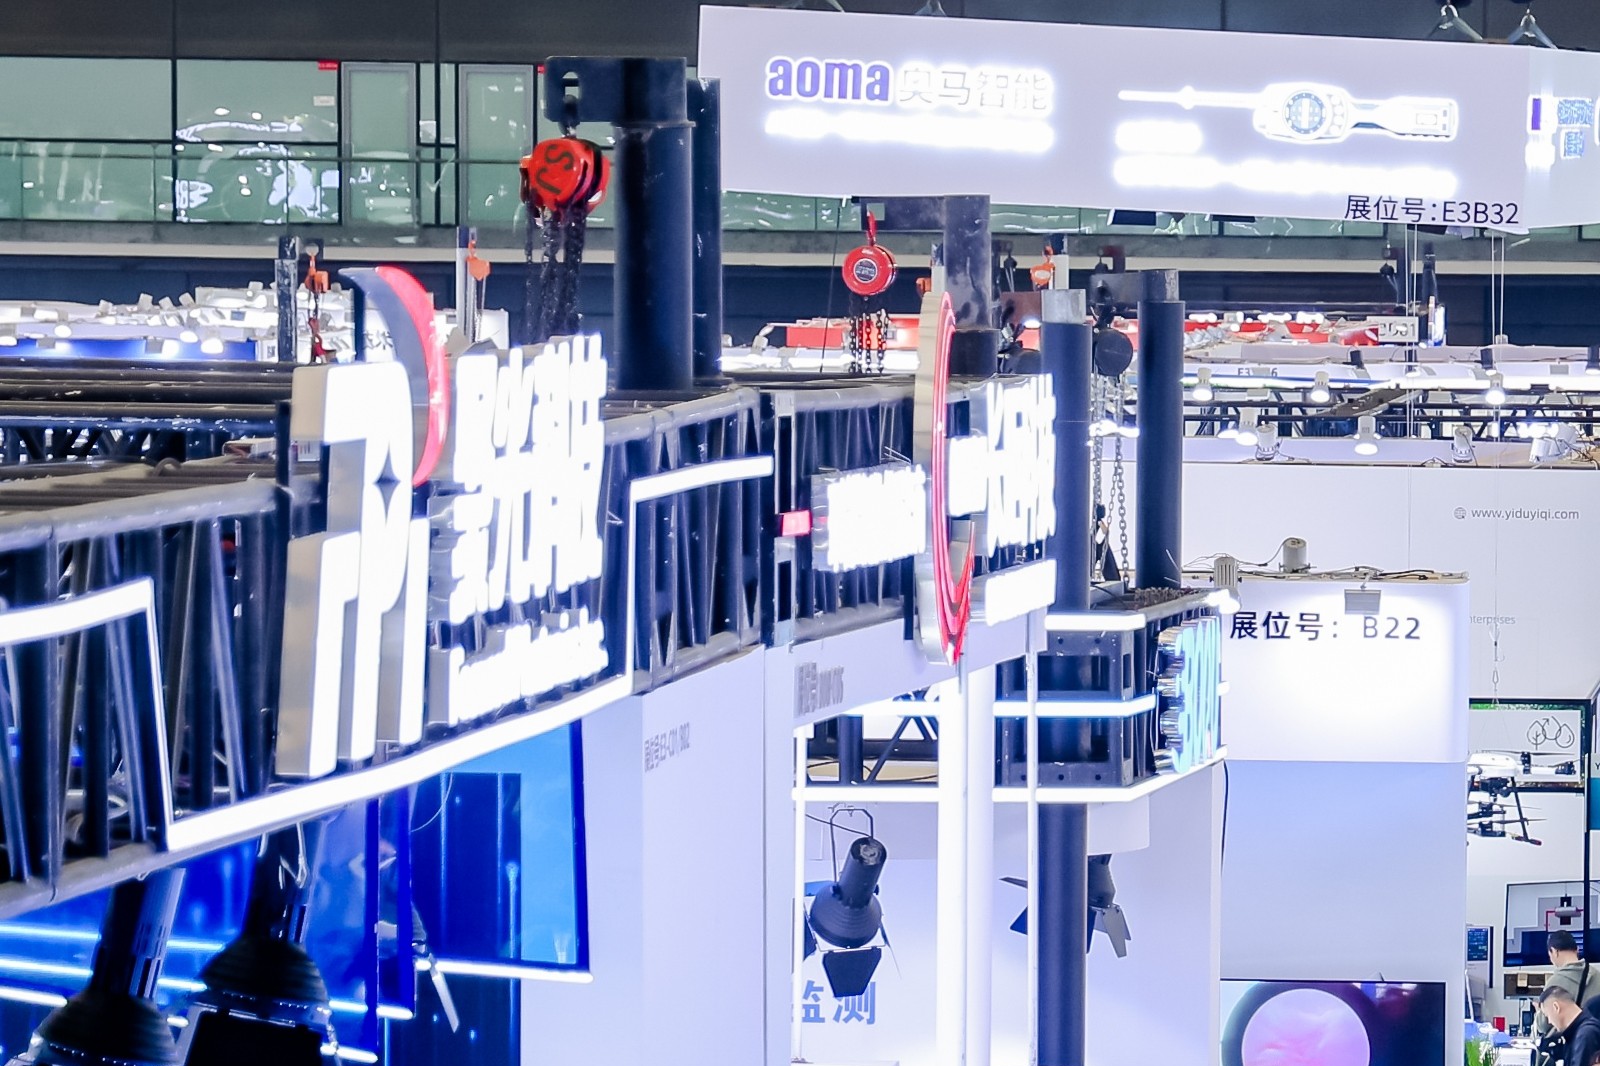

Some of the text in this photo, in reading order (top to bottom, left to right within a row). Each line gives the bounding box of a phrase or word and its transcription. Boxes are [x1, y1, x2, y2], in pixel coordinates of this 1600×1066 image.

[768, 59, 1049, 111] aoma 奥马智能
[1344, 195, 1520, 225] 展位号:E3B32
[1471, 508, 1580, 522] www.yiduyiqi.com
